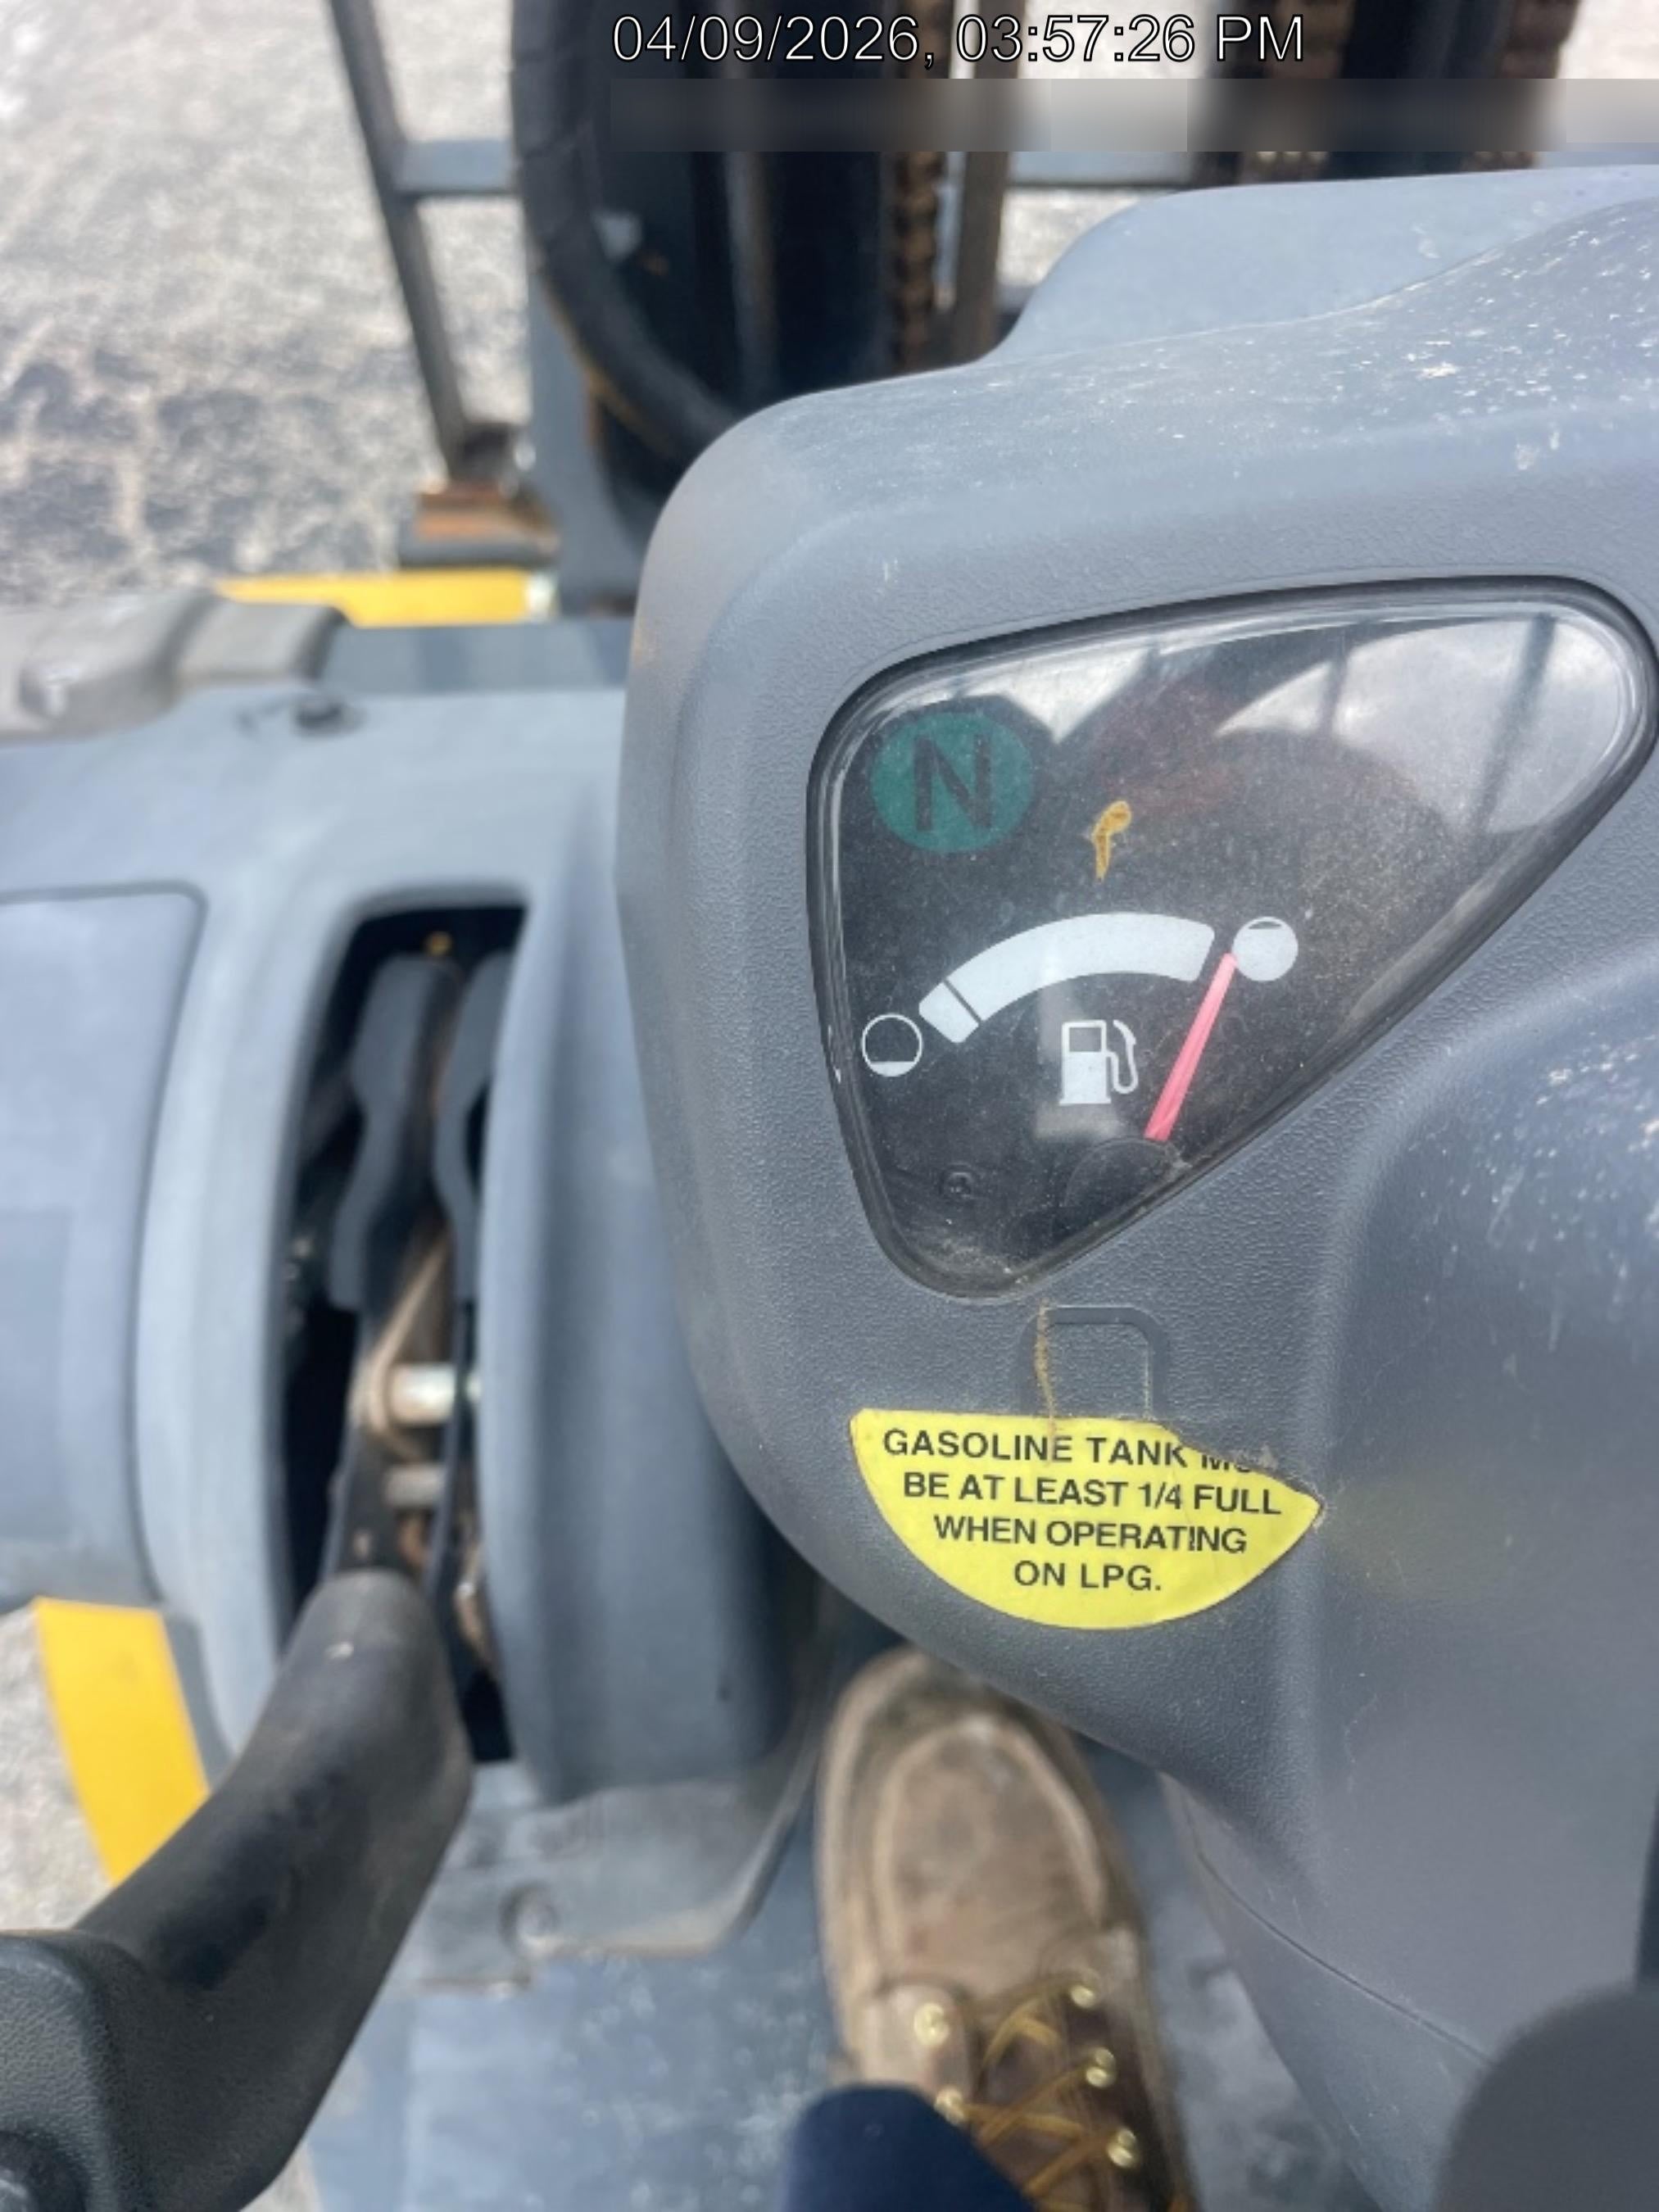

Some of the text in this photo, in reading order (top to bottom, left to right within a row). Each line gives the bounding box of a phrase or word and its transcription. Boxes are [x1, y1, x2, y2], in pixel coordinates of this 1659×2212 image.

[916, 735, 991, 831] N
[883, 1428, 1073, 1462] GASOLINE
[1086, 1437, 1187, 1468] TANK
[904, 1471, 1281, 1515] BE AT LEAST 1/4 FULL
[934, 1515, 1248, 1553] WHEN OPERATING
[1014, 1560, 1161, 1591] ON LPG.
